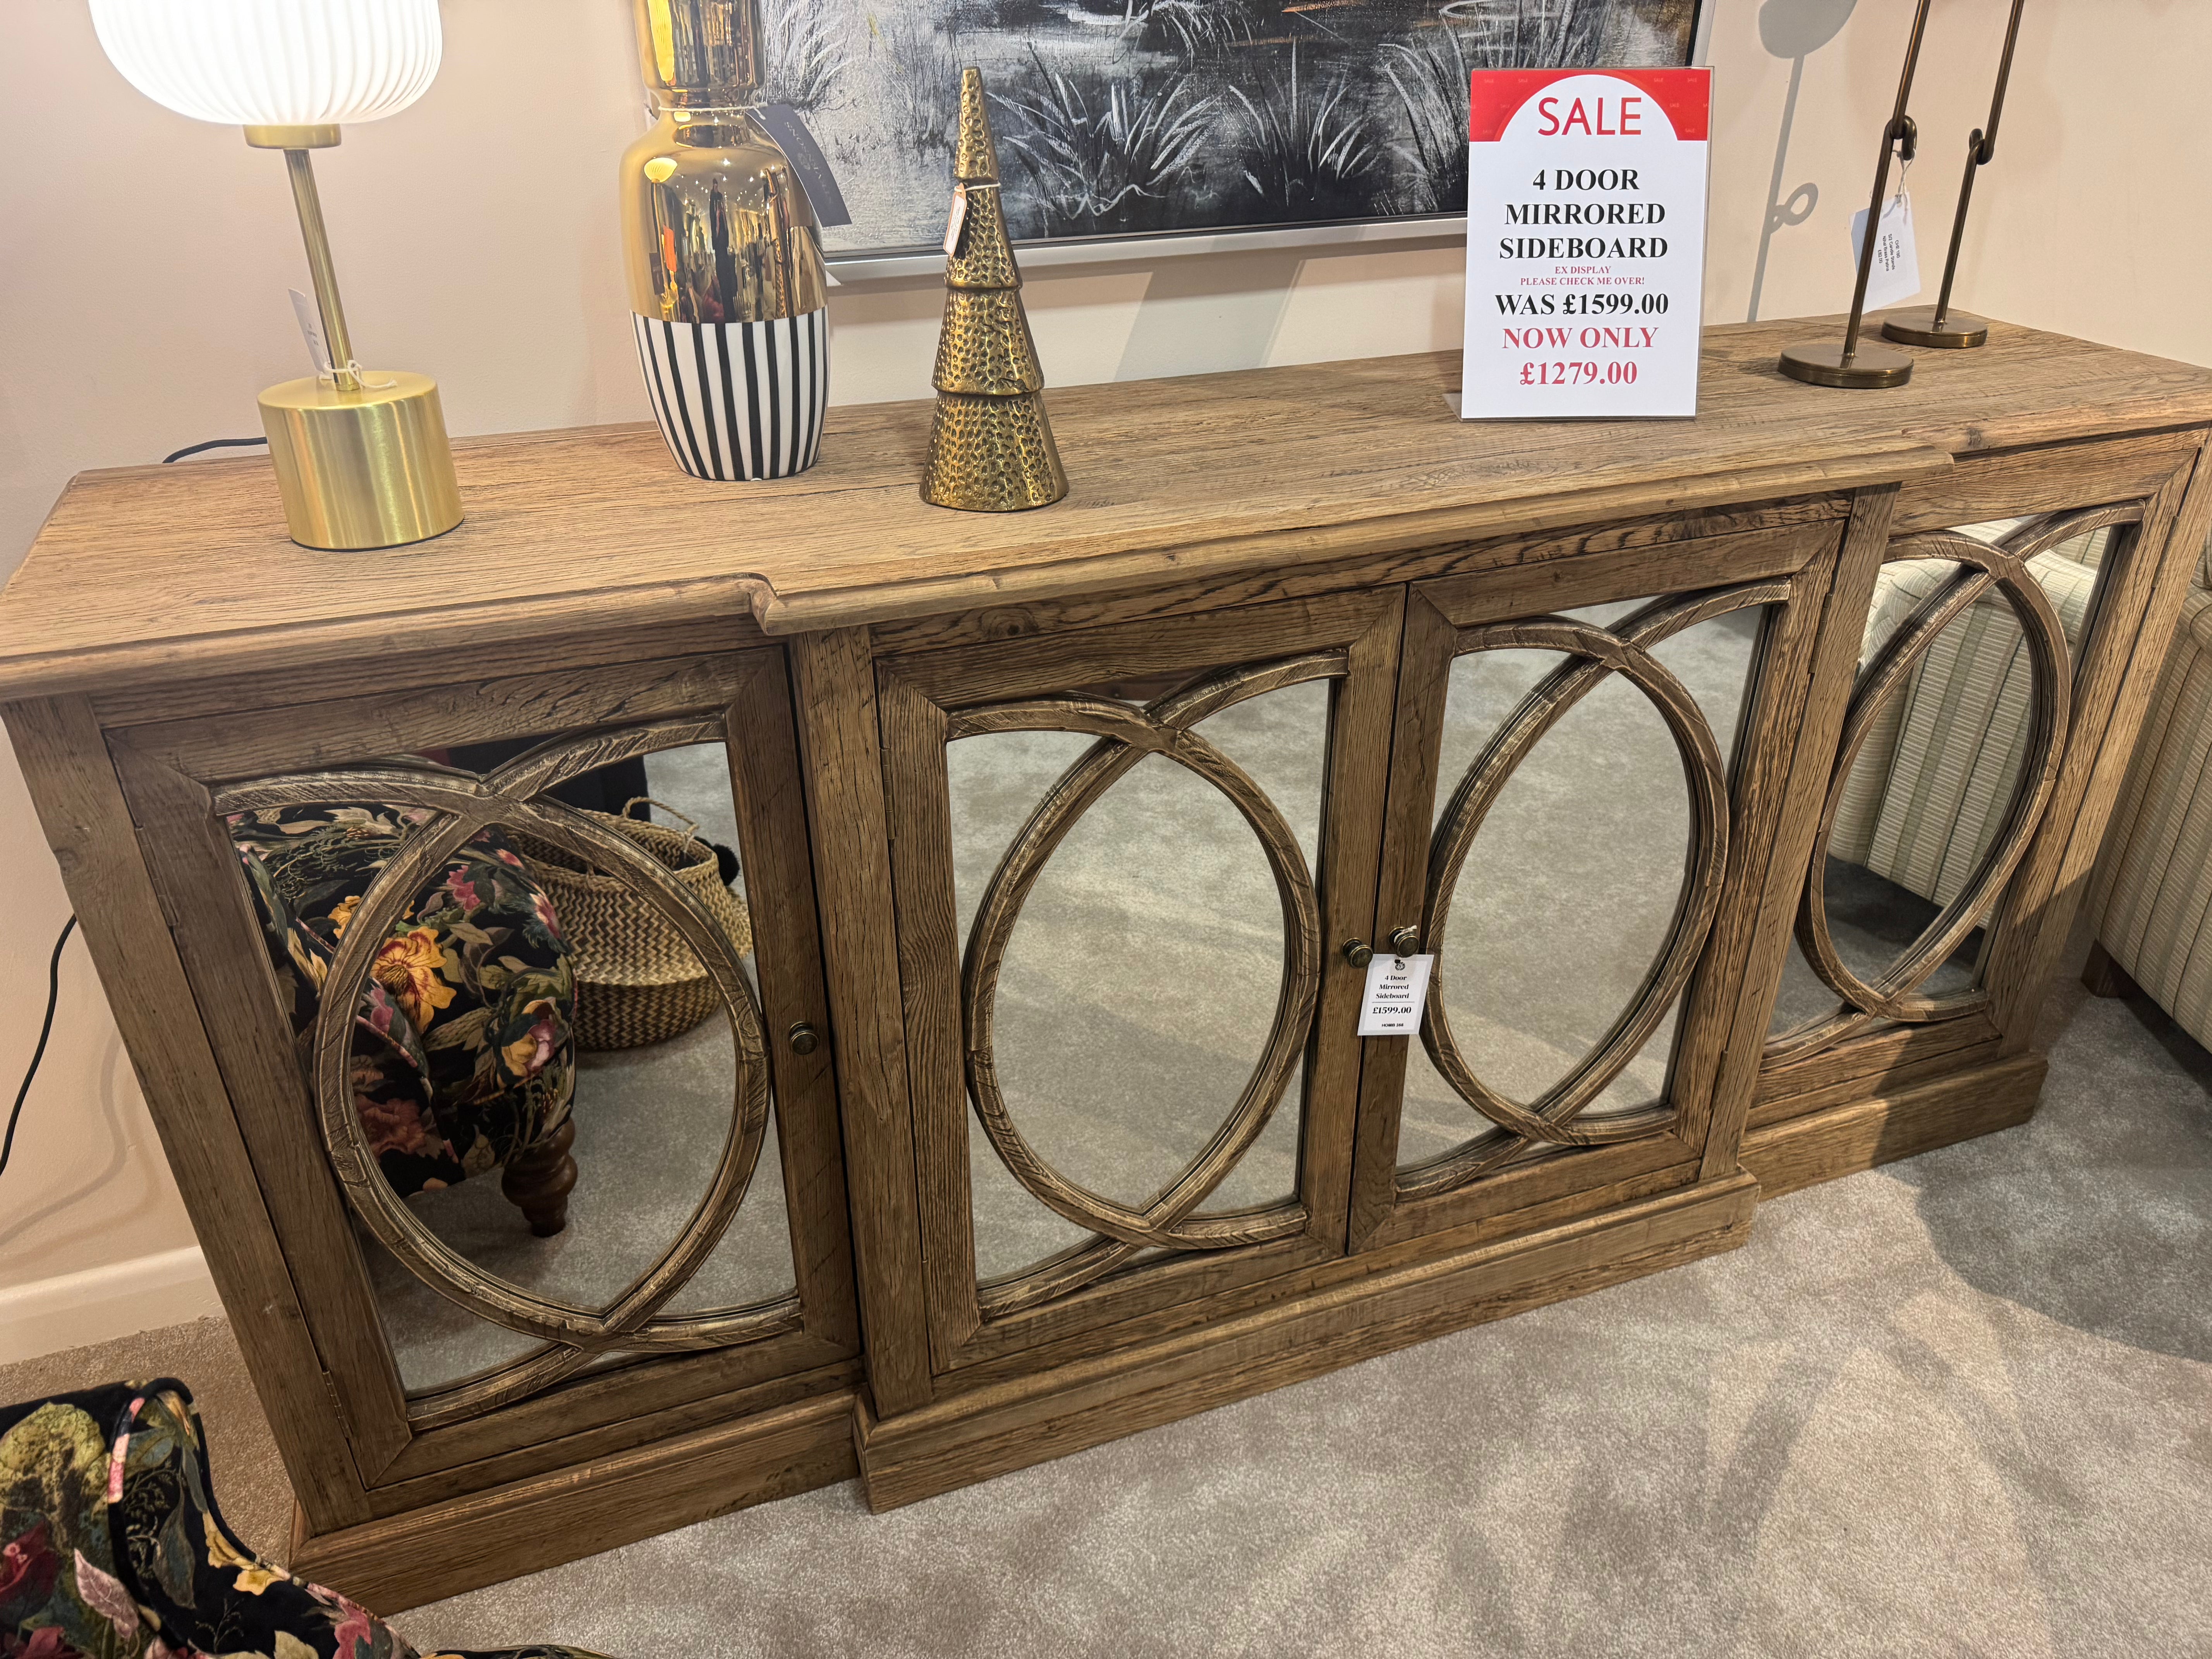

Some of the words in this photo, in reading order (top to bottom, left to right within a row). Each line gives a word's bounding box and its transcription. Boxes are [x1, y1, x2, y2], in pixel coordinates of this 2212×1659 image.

[1538, 97, 1642, 136] SALE
[1533, 169, 1546, 190] 4
[1554, 169, 1640, 190] DOOR
[1504, 203, 1665, 225] MIRRORED
[1499, 237, 1668, 259] SIDEBOARD
[1555, 266, 1567, 274] EX
[1571, 266, 1611, 274] DISPLAY
[1597, 277, 1612, 285] ME
[1495, 294, 1555, 316] WAS
[1563, 294, 1668, 314] £1599.00
[1502, 328, 1573, 349] NOW
[1580, 327, 1659, 348] ONLY
[1520, 361, 1637, 385] £1279.00
